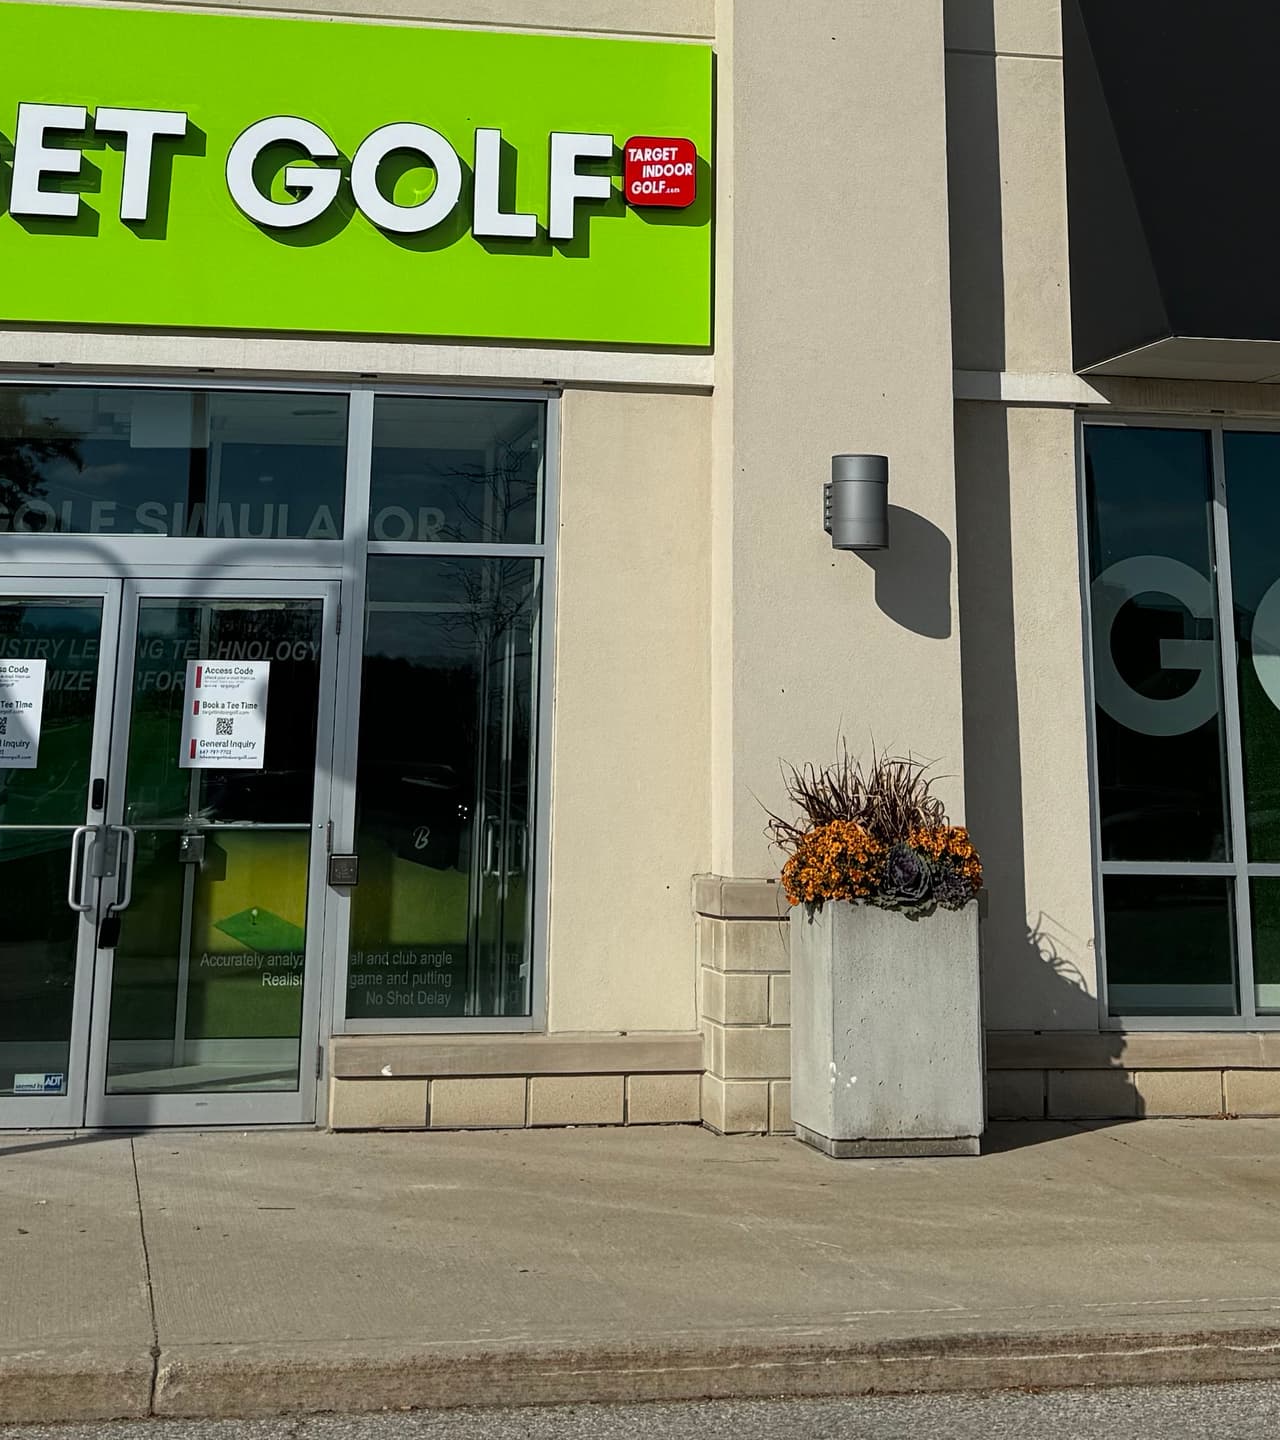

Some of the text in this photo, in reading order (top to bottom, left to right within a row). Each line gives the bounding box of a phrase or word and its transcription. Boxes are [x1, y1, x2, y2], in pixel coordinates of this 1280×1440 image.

[628, 147, 678, 162] TARGET
[642, 163, 693, 178] INDOOR
[224, 115, 615, 242] GOLF
[135, 502, 449, 541] SIMULAOR
[171, 638, 320, 661] TECHNOLOGY
[8, 665, 29, 673] Code
[204, 666, 254, 675] Access Code
[202, 701, 219, 709] Book
[3, 739, 31, 749] Inquiry
[199, 740, 257, 750] General Inquiry
[200, 952, 264, 970] Accurately
[266, 953, 304, 970] analyz
[366, 951, 389, 966] and
[392, 951, 416, 966] club
[419, 951, 453, 969] angle
[350, 973, 382, 989] game
[387, 971, 409, 985] and
[412, 971, 453, 989] putting
[366, 990, 452, 1009] No Shot Delay
[45, 1076, 63, 1086] ADT
